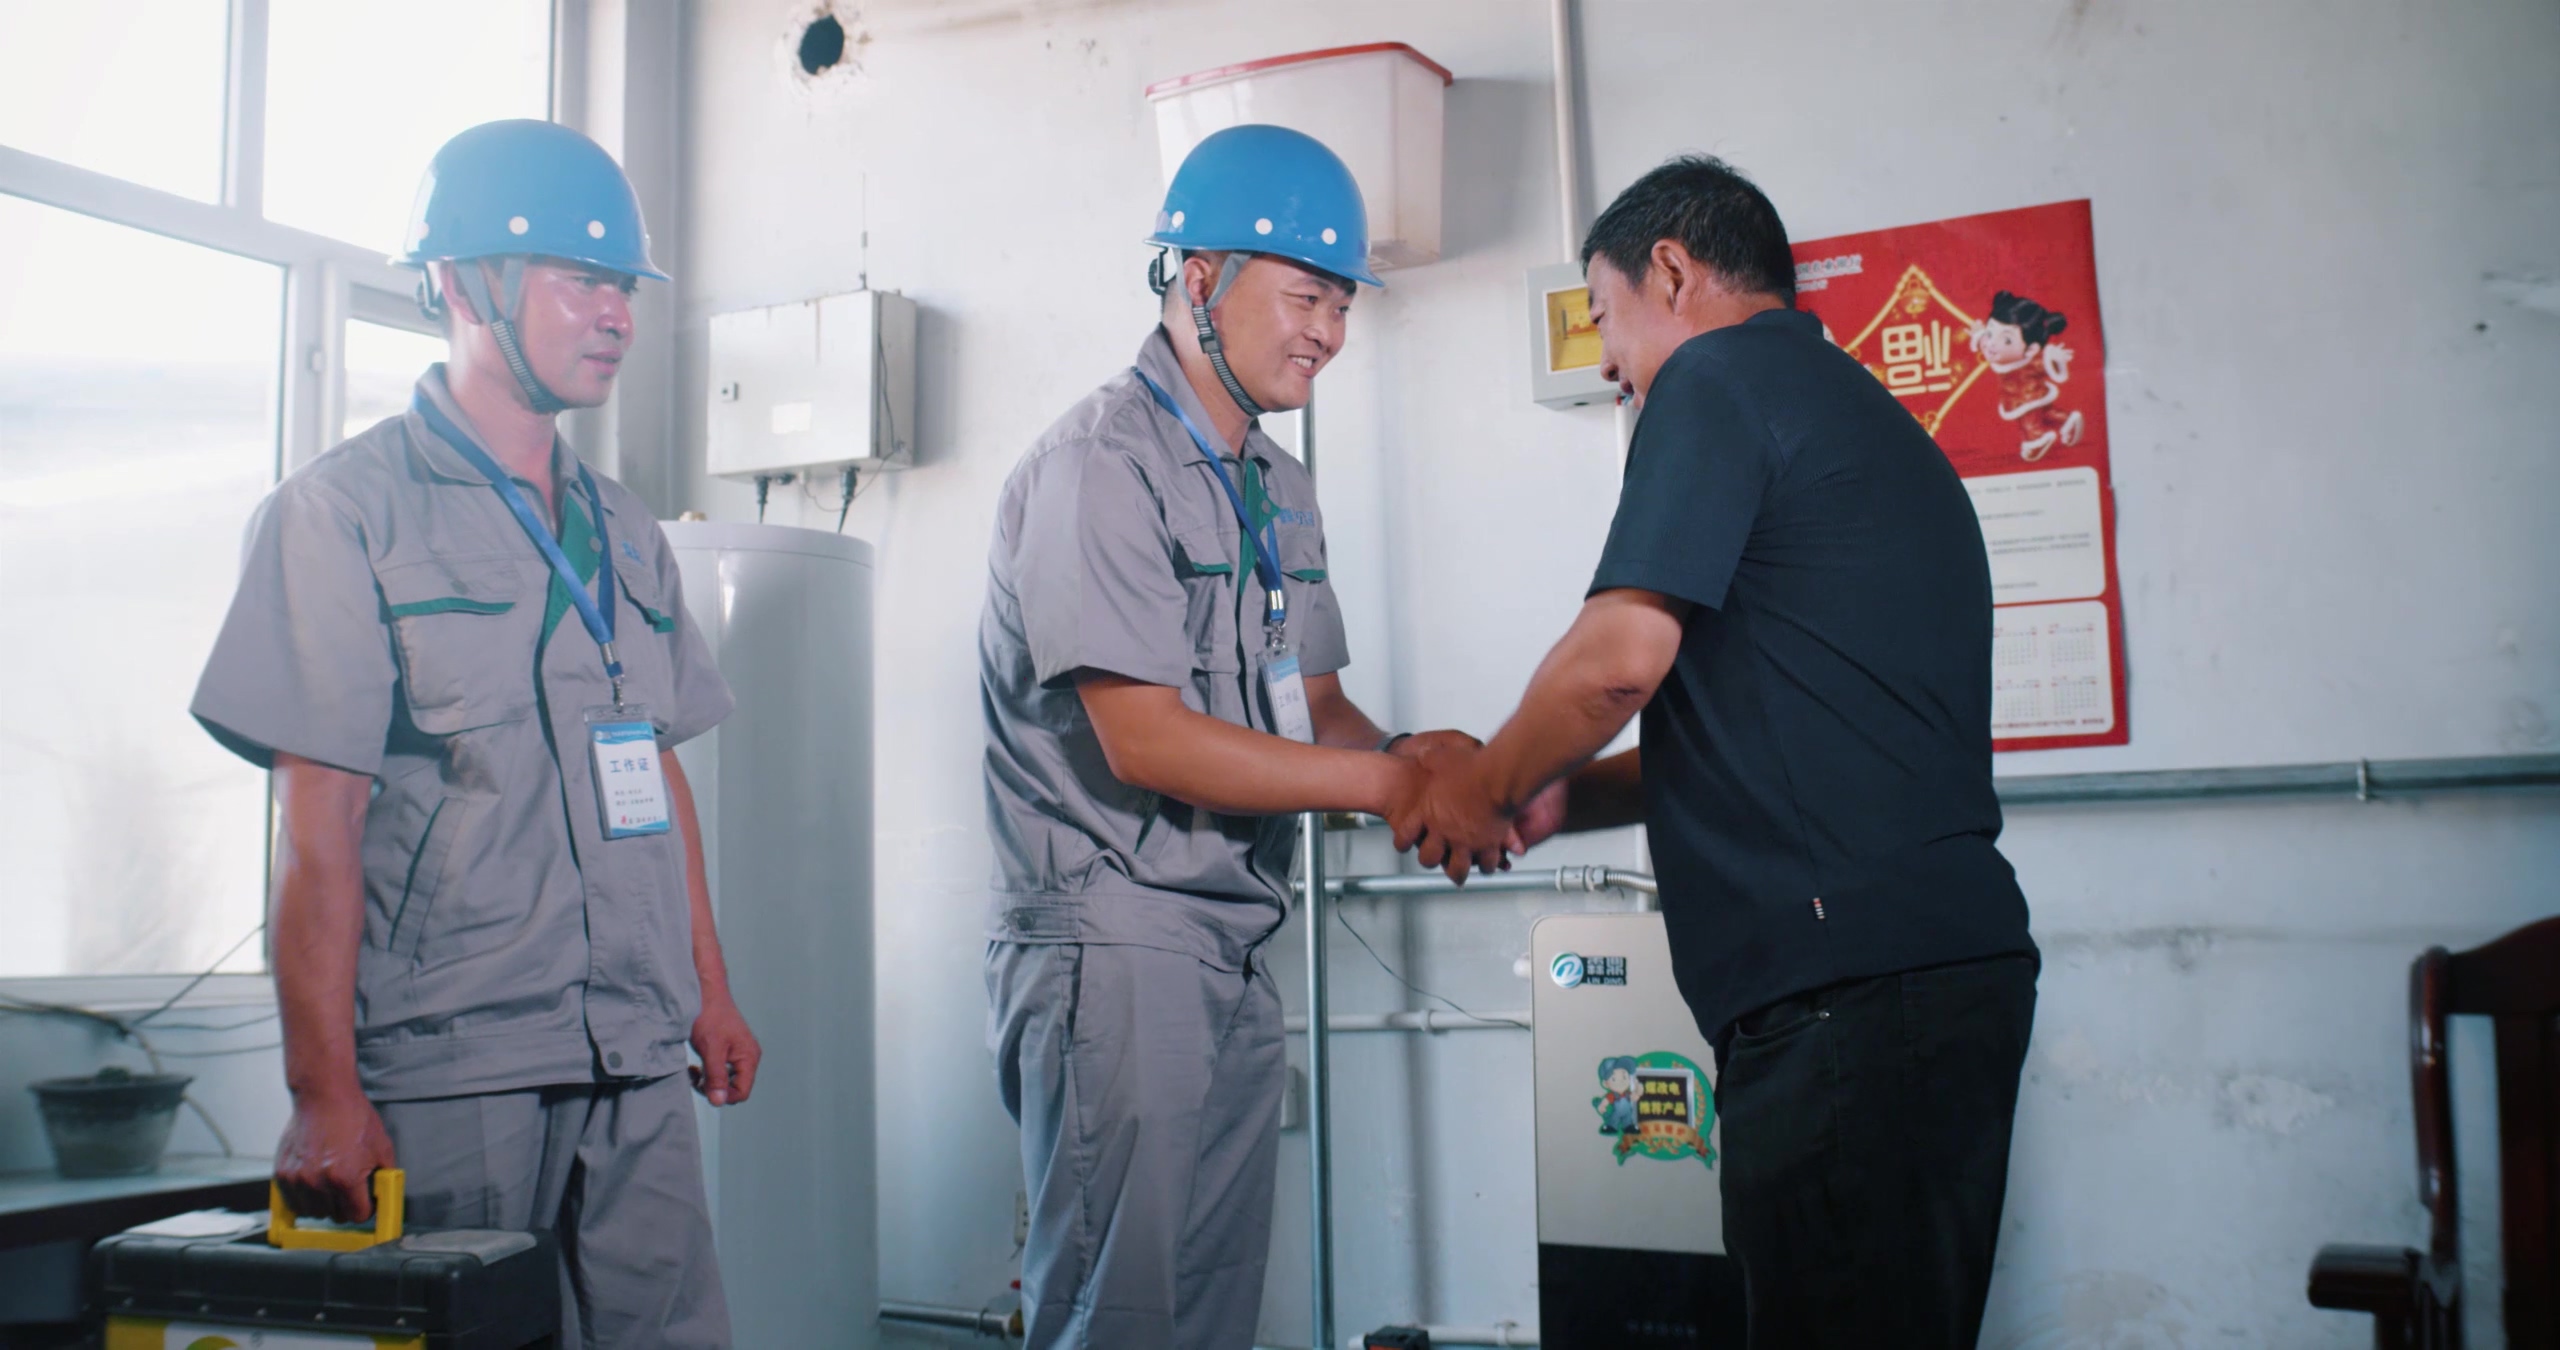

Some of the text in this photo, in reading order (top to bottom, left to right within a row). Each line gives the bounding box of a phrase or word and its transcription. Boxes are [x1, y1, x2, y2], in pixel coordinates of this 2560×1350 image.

[1882, 320, 1952, 397] 福
[609, 757, 650, 773] 工作证
[1586, 977, 1601, 985] LIN
[1638, 1100, 1687, 1116] 推荐产品
